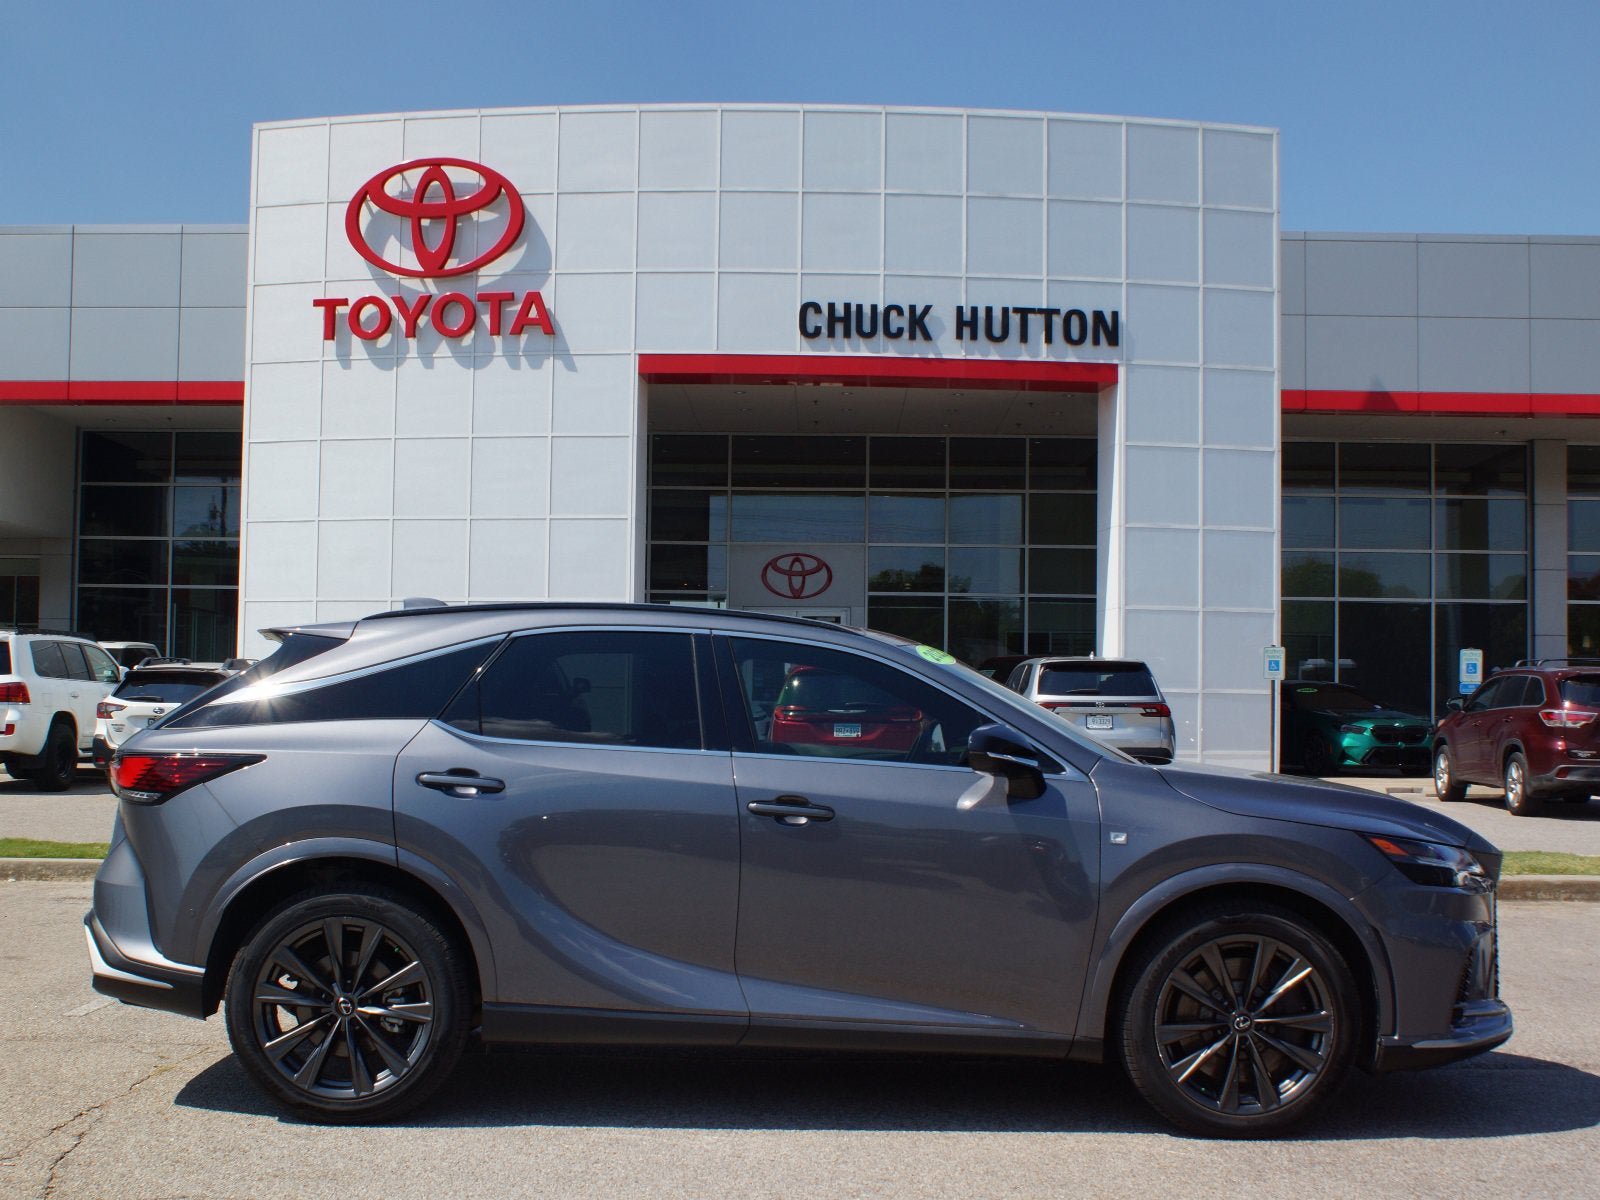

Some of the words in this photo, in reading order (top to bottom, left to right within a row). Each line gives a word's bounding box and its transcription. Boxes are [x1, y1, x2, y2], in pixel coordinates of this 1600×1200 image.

[313, 291, 555, 341] TOYOTA
[798, 301, 933, 341] CHUCK
[955, 305, 1119, 347] HUTTON
